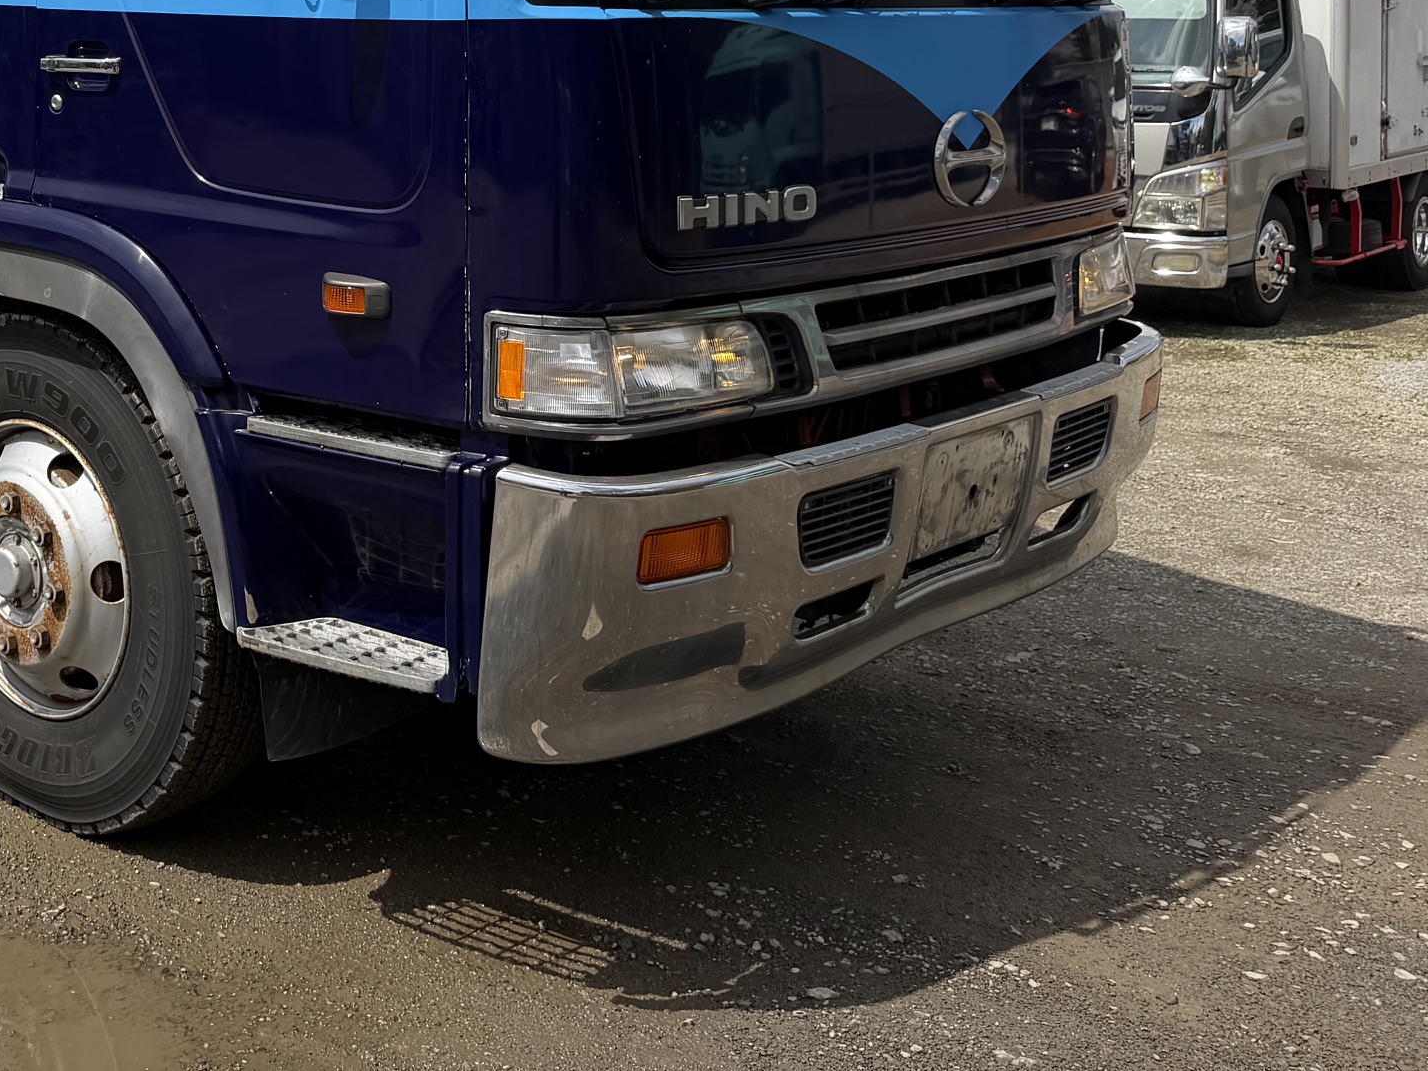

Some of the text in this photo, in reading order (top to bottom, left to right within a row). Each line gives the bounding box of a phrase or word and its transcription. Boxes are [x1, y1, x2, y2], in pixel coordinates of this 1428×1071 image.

[677, 183, 818, 232] HINO
[4, 365, 127, 486] W900
[123, 583, 161, 737] STUDLESS
